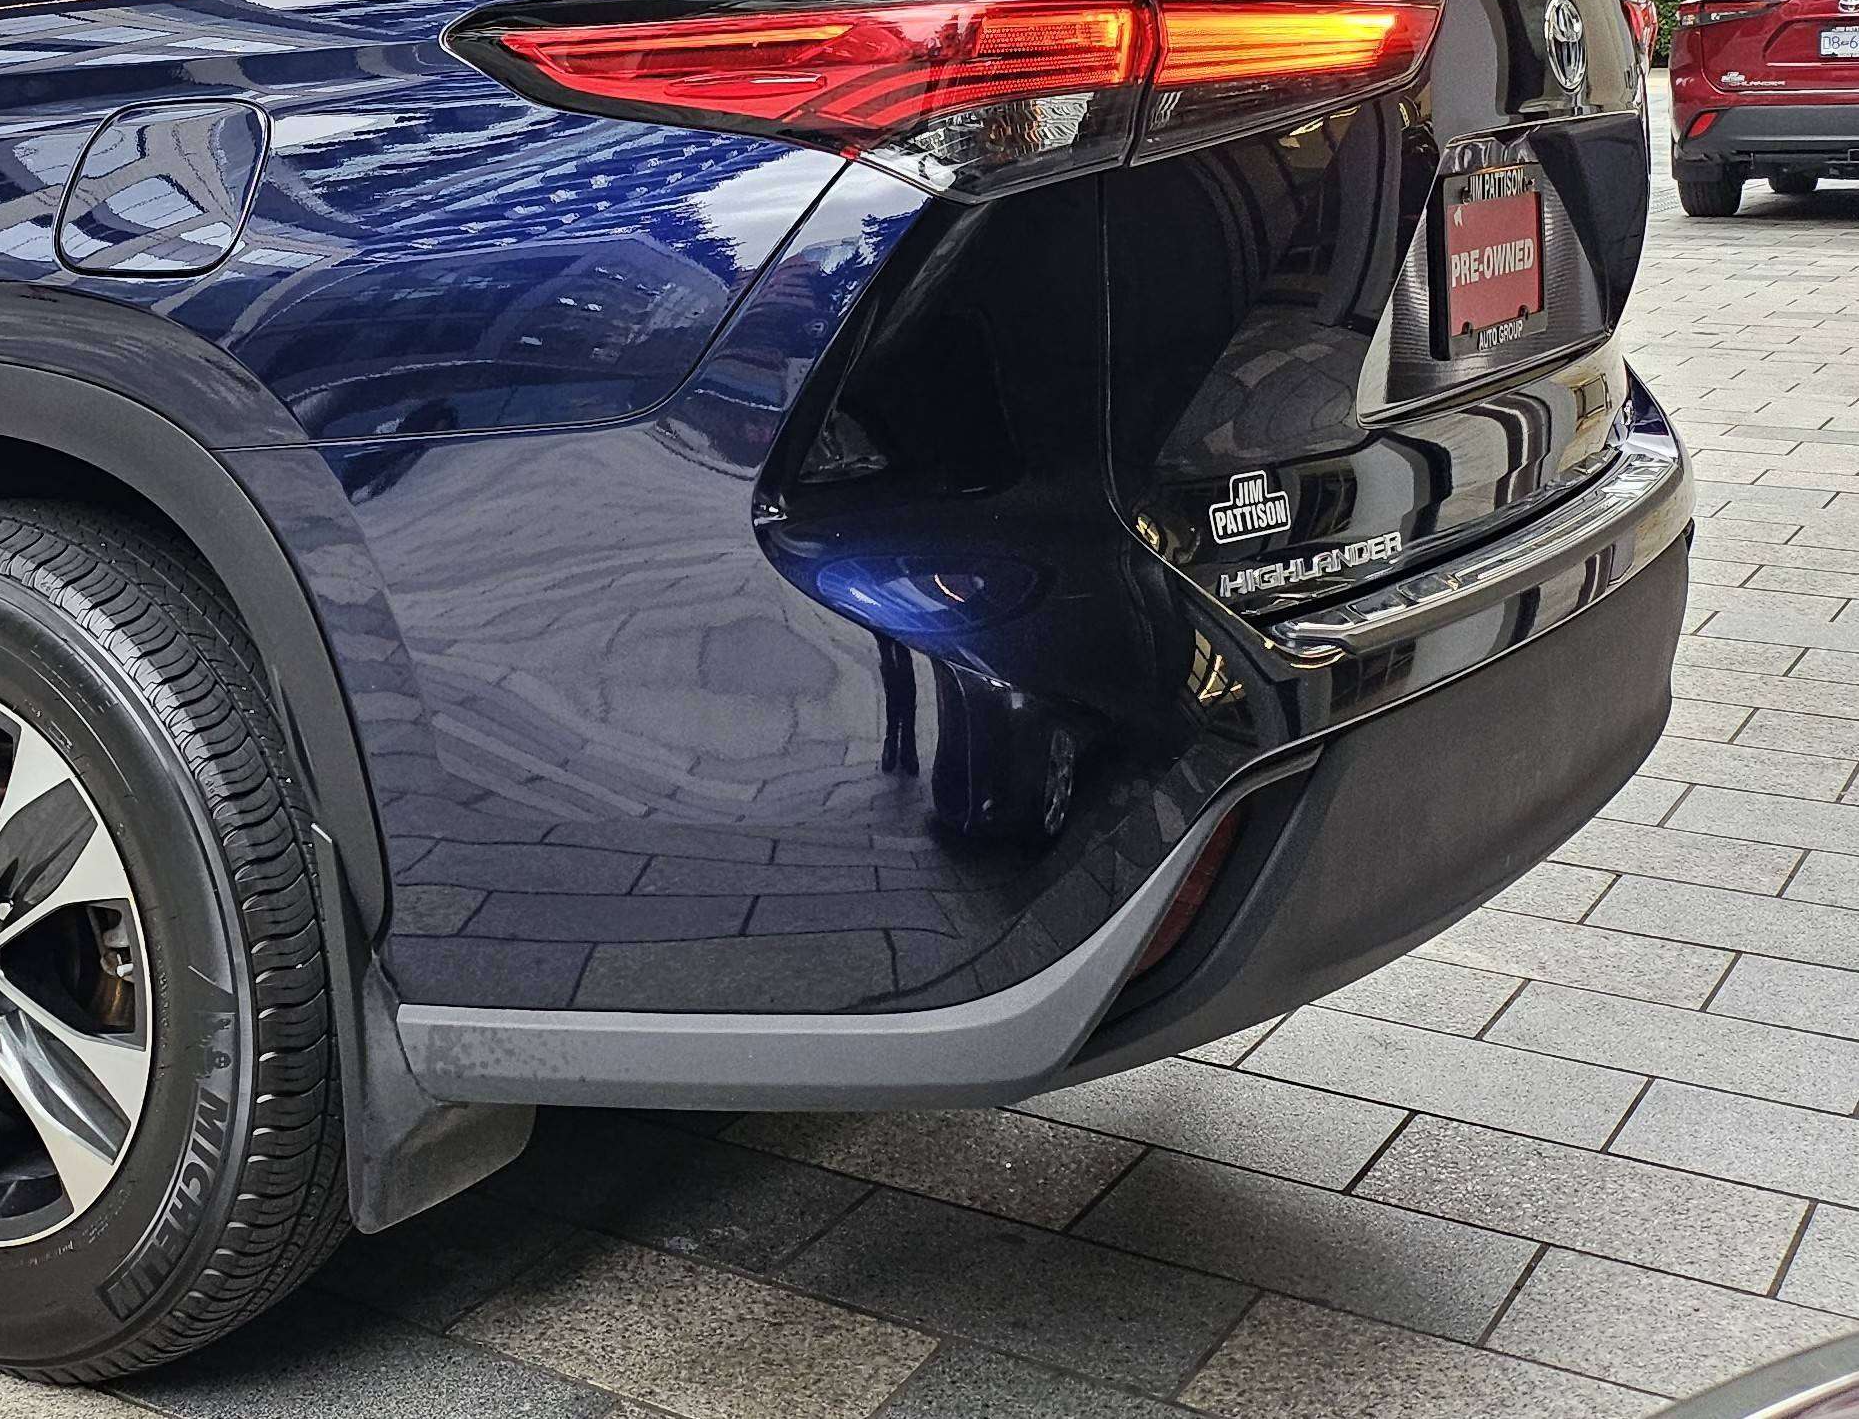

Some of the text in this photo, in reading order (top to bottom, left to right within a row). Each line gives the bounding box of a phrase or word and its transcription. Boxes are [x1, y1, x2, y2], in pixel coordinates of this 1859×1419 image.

[1468, 169, 1524, 202] JIM PATTISON
[1450, 238, 1535, 288] PRE-OWNED
[1478, 320, 1524, 350] AUTO GROUP
[1236, 478, 1264, 507] JIM
[1214, 499, 1287, 537] PATTISON
[1219, 531, 1403, 598] HIGHLANDER
